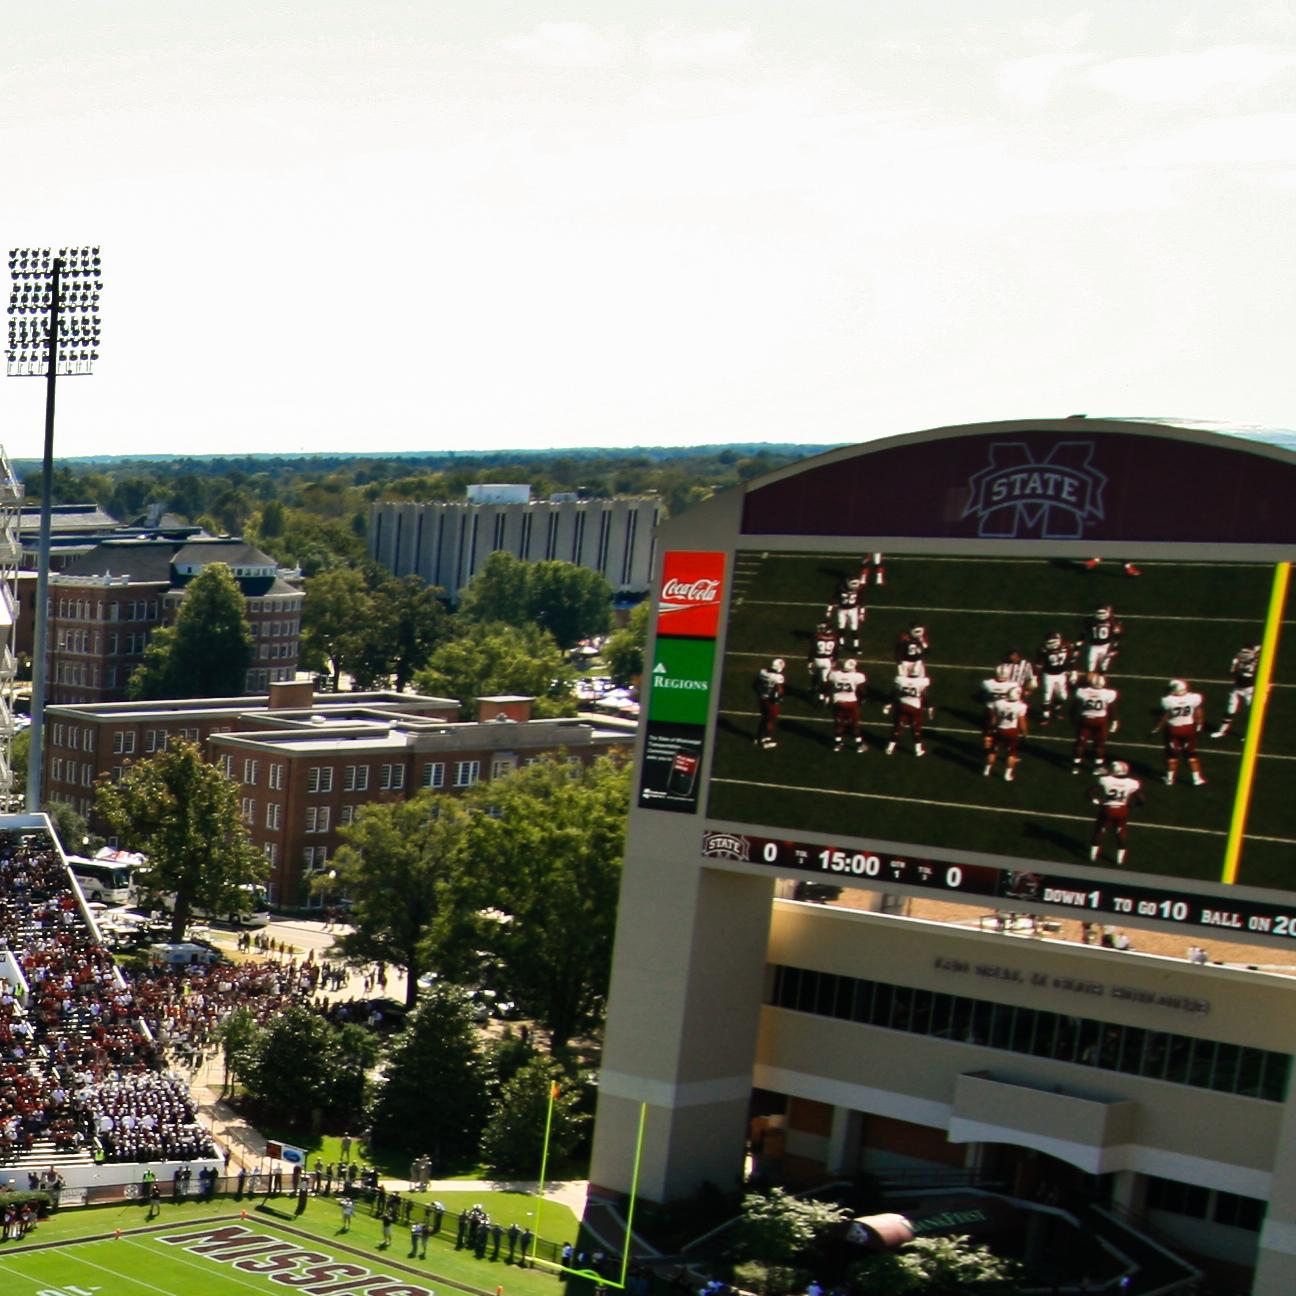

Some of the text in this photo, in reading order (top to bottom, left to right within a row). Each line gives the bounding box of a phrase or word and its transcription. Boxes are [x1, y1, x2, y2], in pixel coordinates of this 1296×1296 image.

[991, 472, 1079, 502] STATE
[662, 578, 720, 601] Coca-Cola
[654, 675, 708, 690] REGIONS
[709, 837, 741, 854] STATE
[763, 843, 778, 862] 0
[819, 850, 880, 876] 15:00
[946, 867, 962, 888] 0
[1043, 888, 1086, 906] DOWN
[1088, 890, 1101, 909] 1
[1113, 897, 1132, 912] TO
[1137, 901, 1157, 916] GO
[1159, 900, 1189, 921] 10
[1201, 909, 1242, 928] BALL
[1248, 916, 1270, 932] ON
